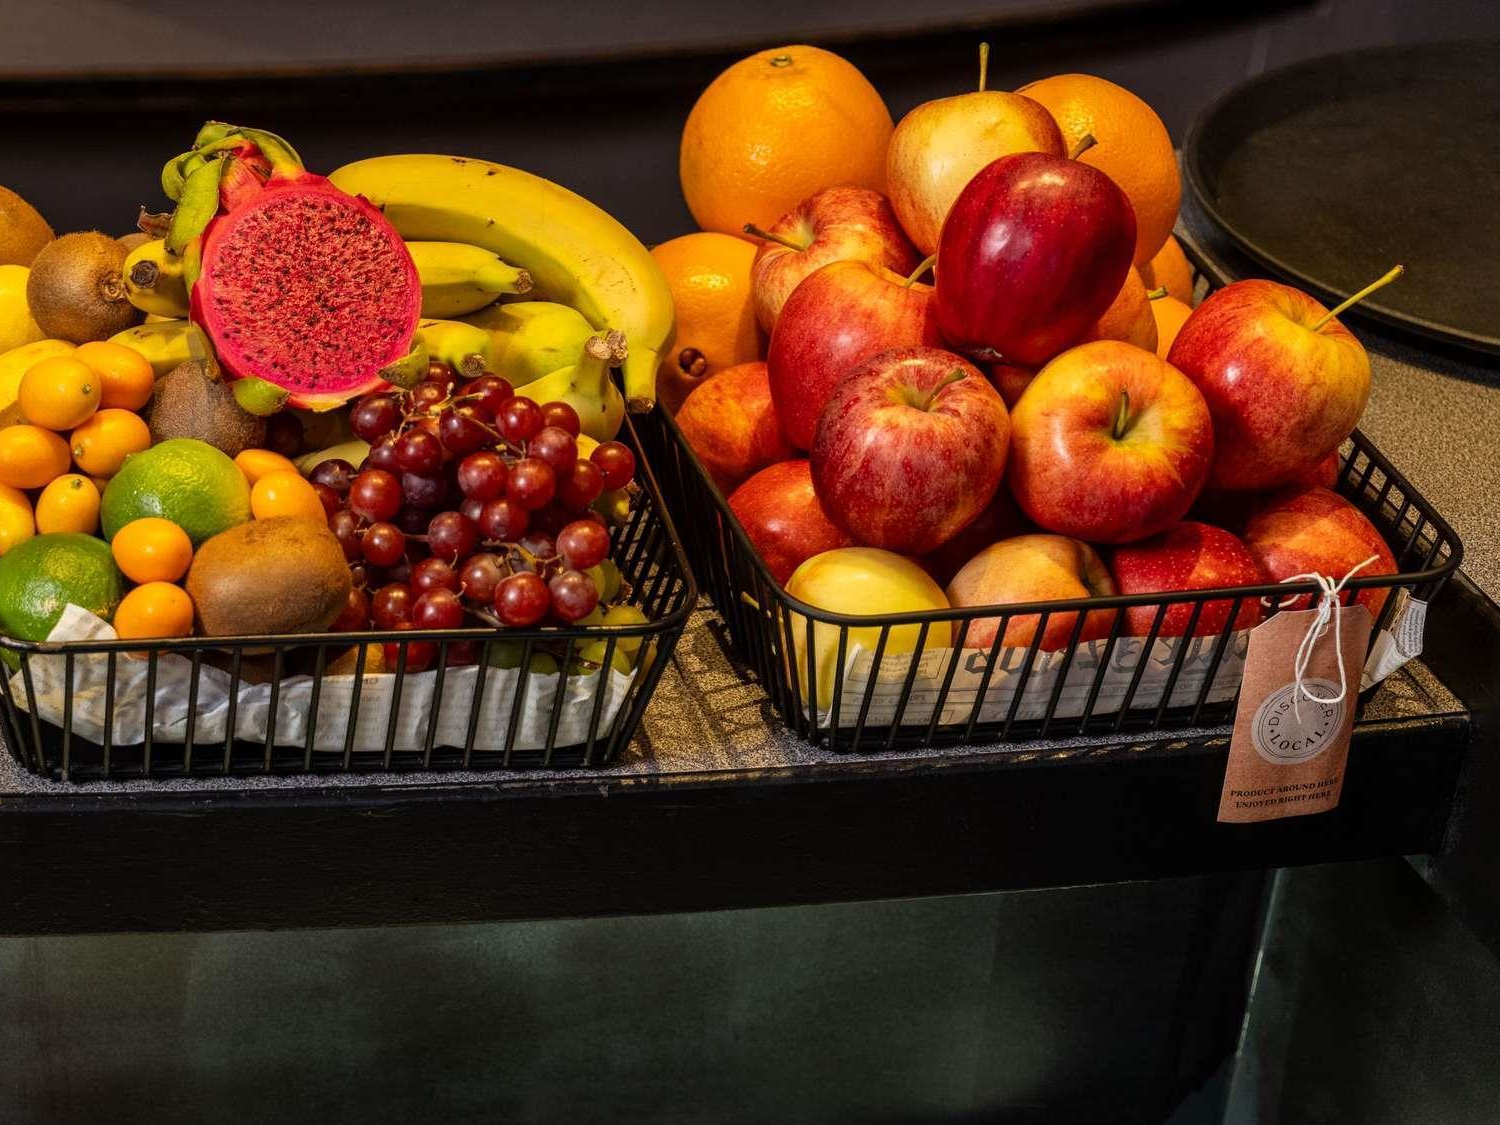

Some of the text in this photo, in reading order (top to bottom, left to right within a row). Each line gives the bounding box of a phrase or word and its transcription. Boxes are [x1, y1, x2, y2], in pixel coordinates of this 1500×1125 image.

[1270, 730, 1326, 751] LOCAL
[1230, 788, 1277, 798] PRODUCT
[1276, 783, 1316, 793] AROUND
[1235, 789, 1332, 809] ENJOYED RIGHT HERE
